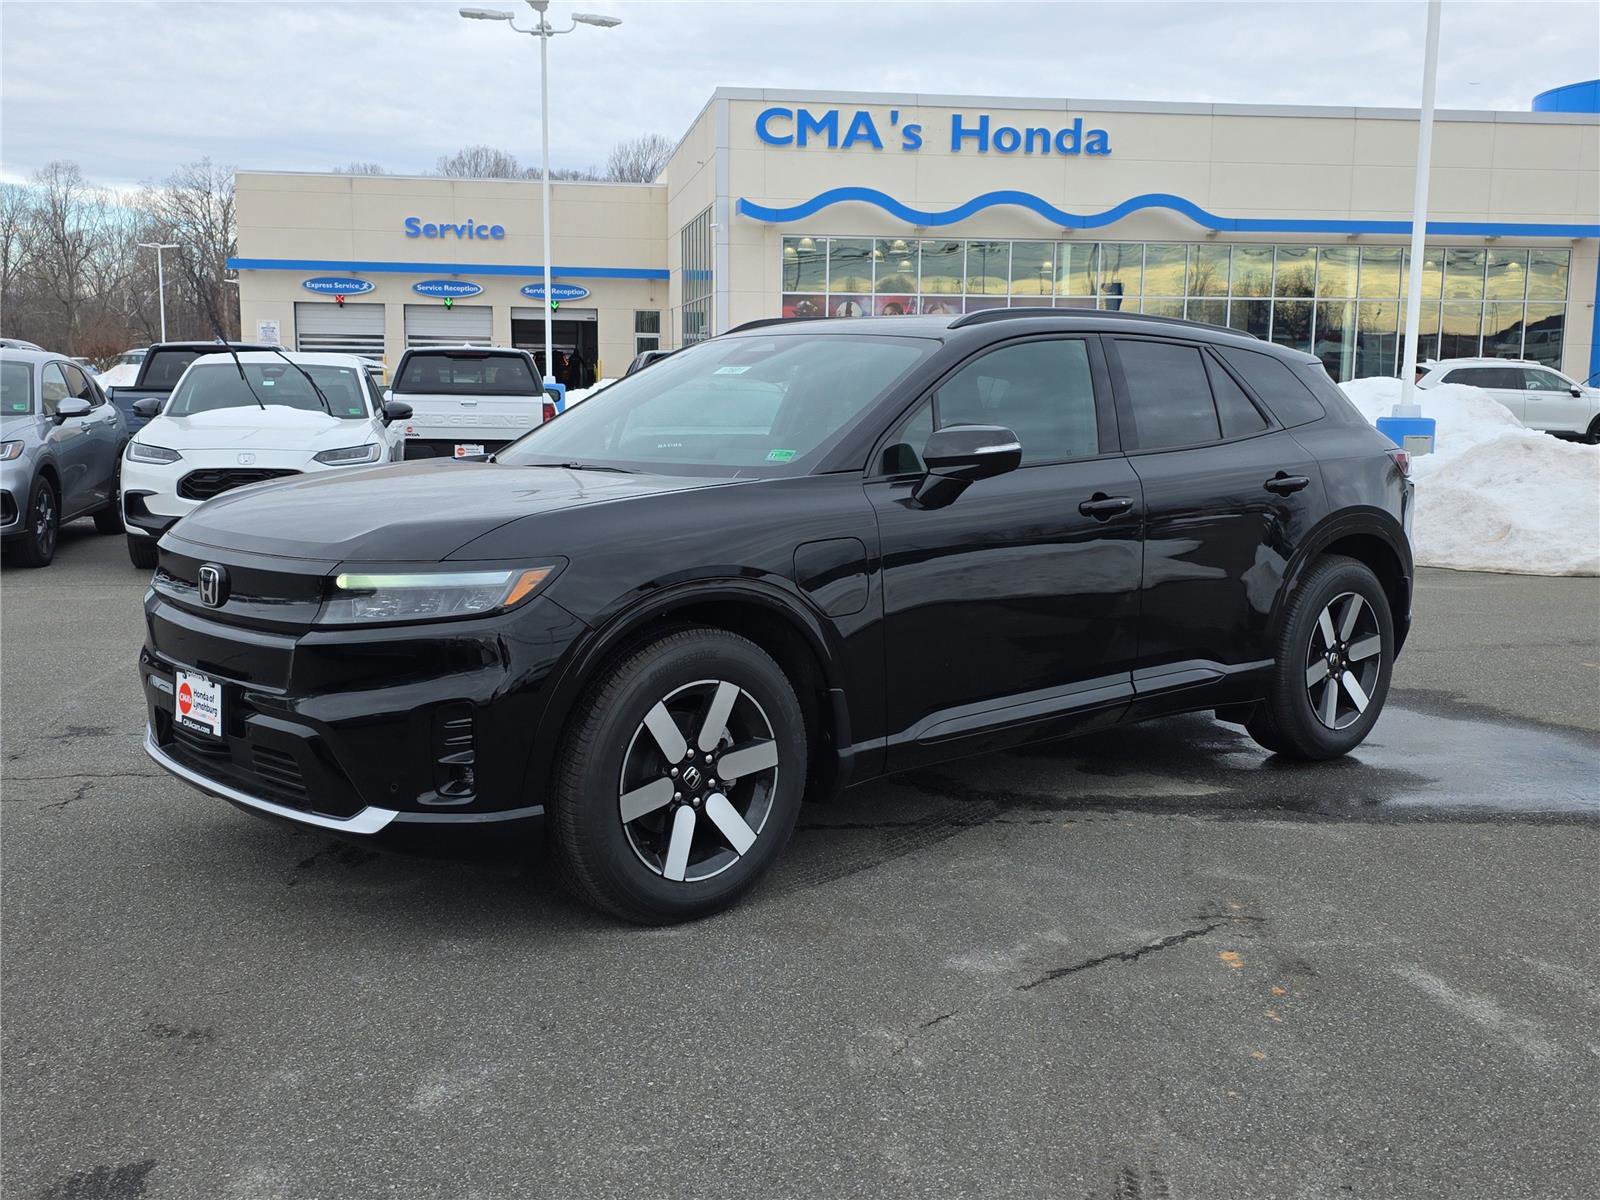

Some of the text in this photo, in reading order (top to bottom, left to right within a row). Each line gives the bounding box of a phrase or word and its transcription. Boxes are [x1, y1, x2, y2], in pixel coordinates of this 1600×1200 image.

[755, 107, 1113, 155] CMA's Honda
[404, 217, 505, 240] Service
[306, 281, 333, 289] Express
[444, 284, 479, 293] Reception
[551, 288, 585, 296] Reception
[193, 689, 215, 704] Honda of
[193, 699, 218, 718] Lynchburg
